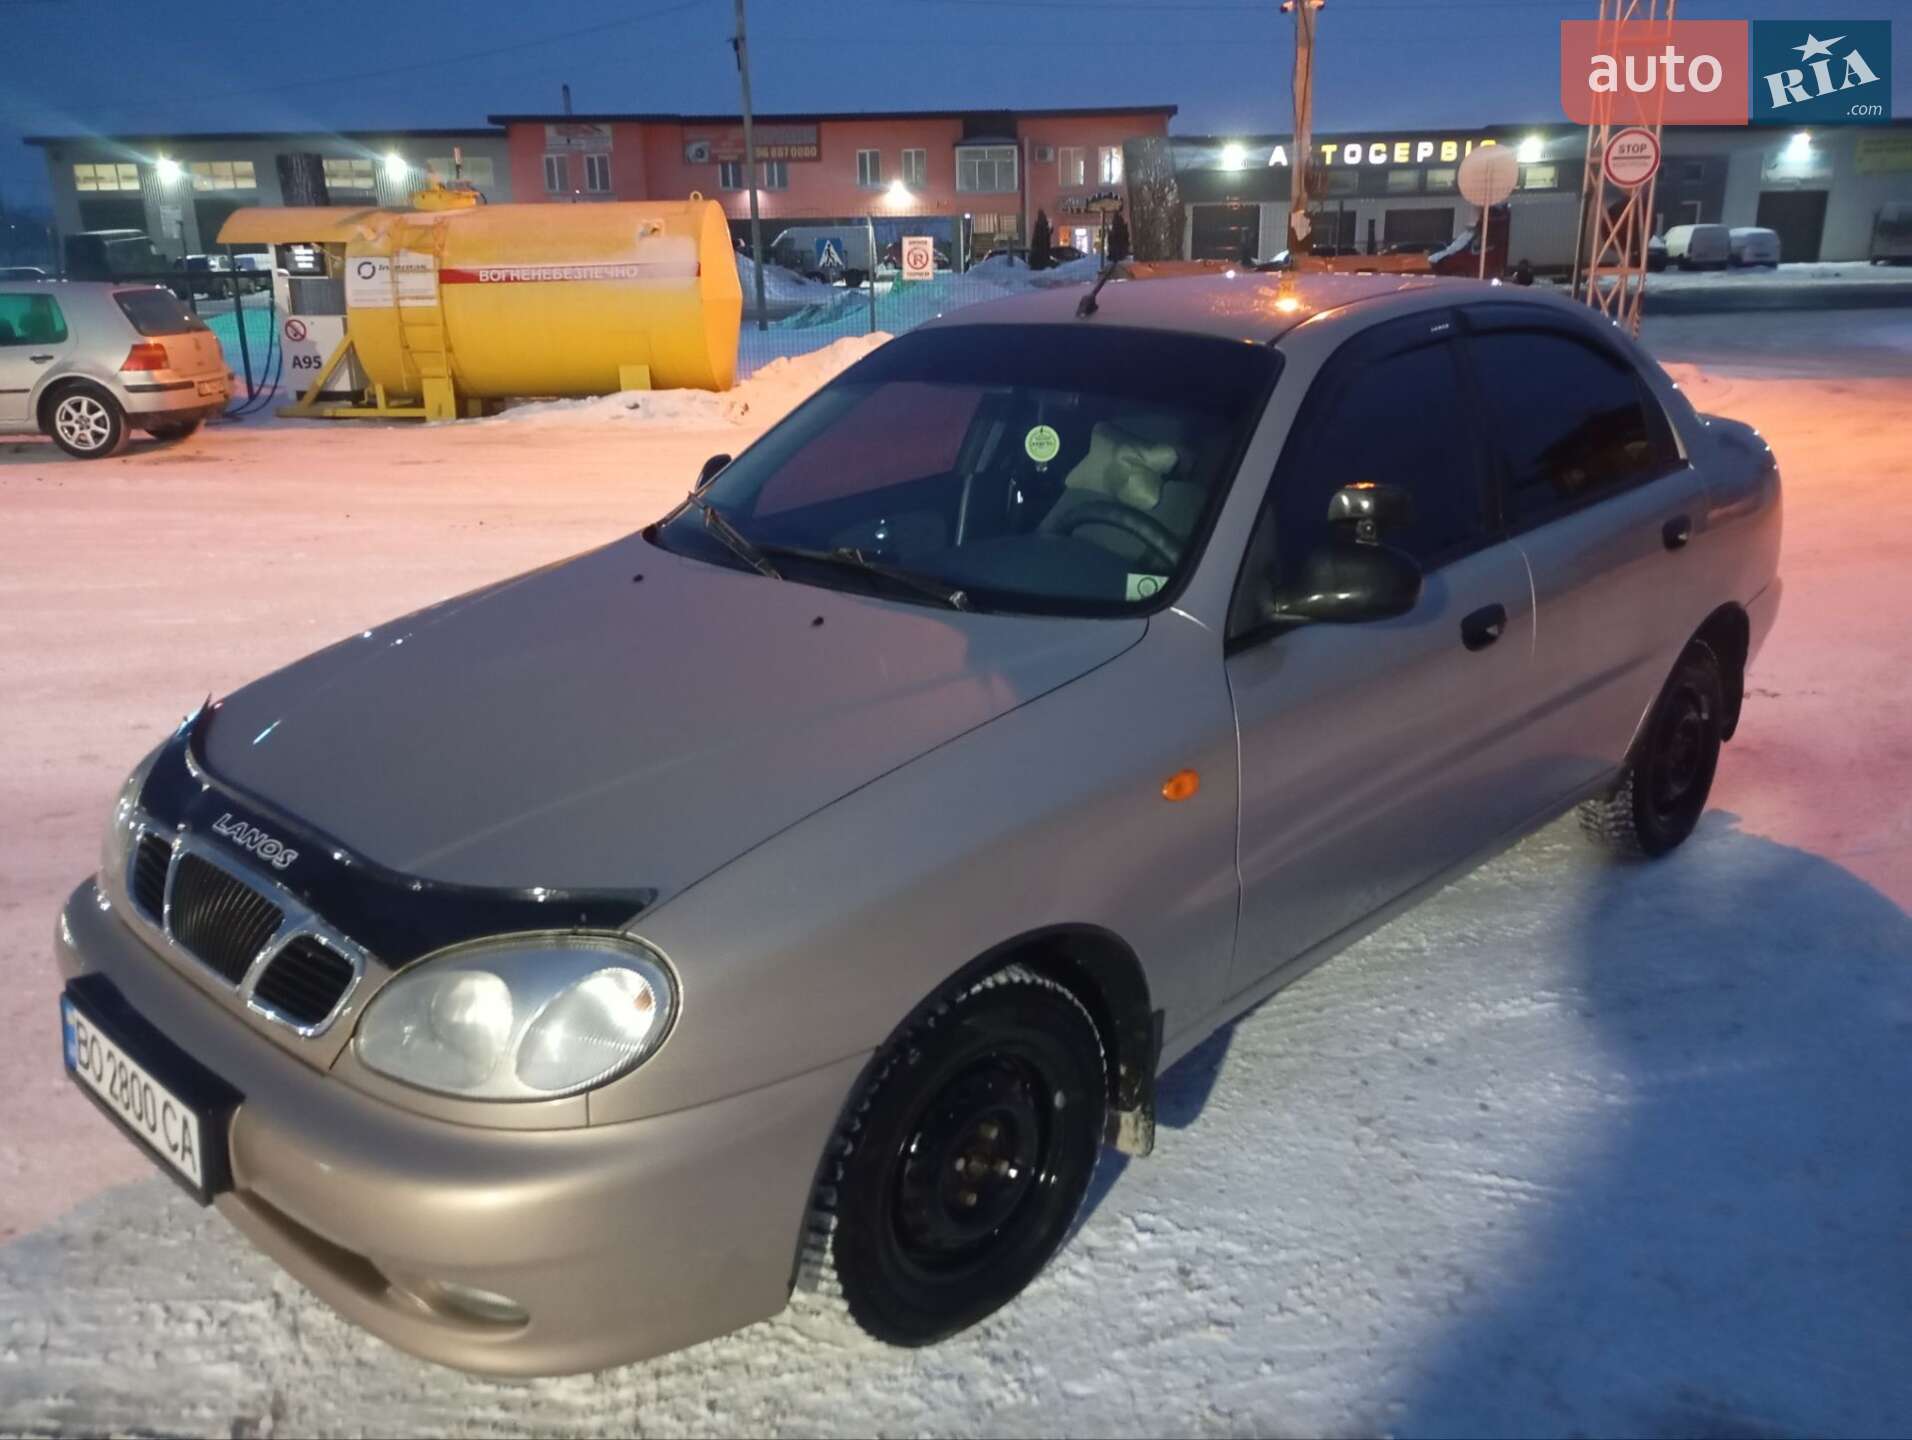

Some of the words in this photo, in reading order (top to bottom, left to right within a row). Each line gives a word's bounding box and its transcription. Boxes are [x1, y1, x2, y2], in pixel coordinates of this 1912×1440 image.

[1268, 139, 1498, 167] АТОСЕРВІ
[1619, 143, 1648, 154] STOP
[478, 265, 639, 282] ВОГНЕНЕБЕЗПЕЧНО
[292, 355, 322, 370] A95
[212, 812, 300, 870] LANOS
[75, 1018, 105, 1083] BO
[107, 1049, 157, 1134] 2800
[162, 1098, 197, 1174] CA
